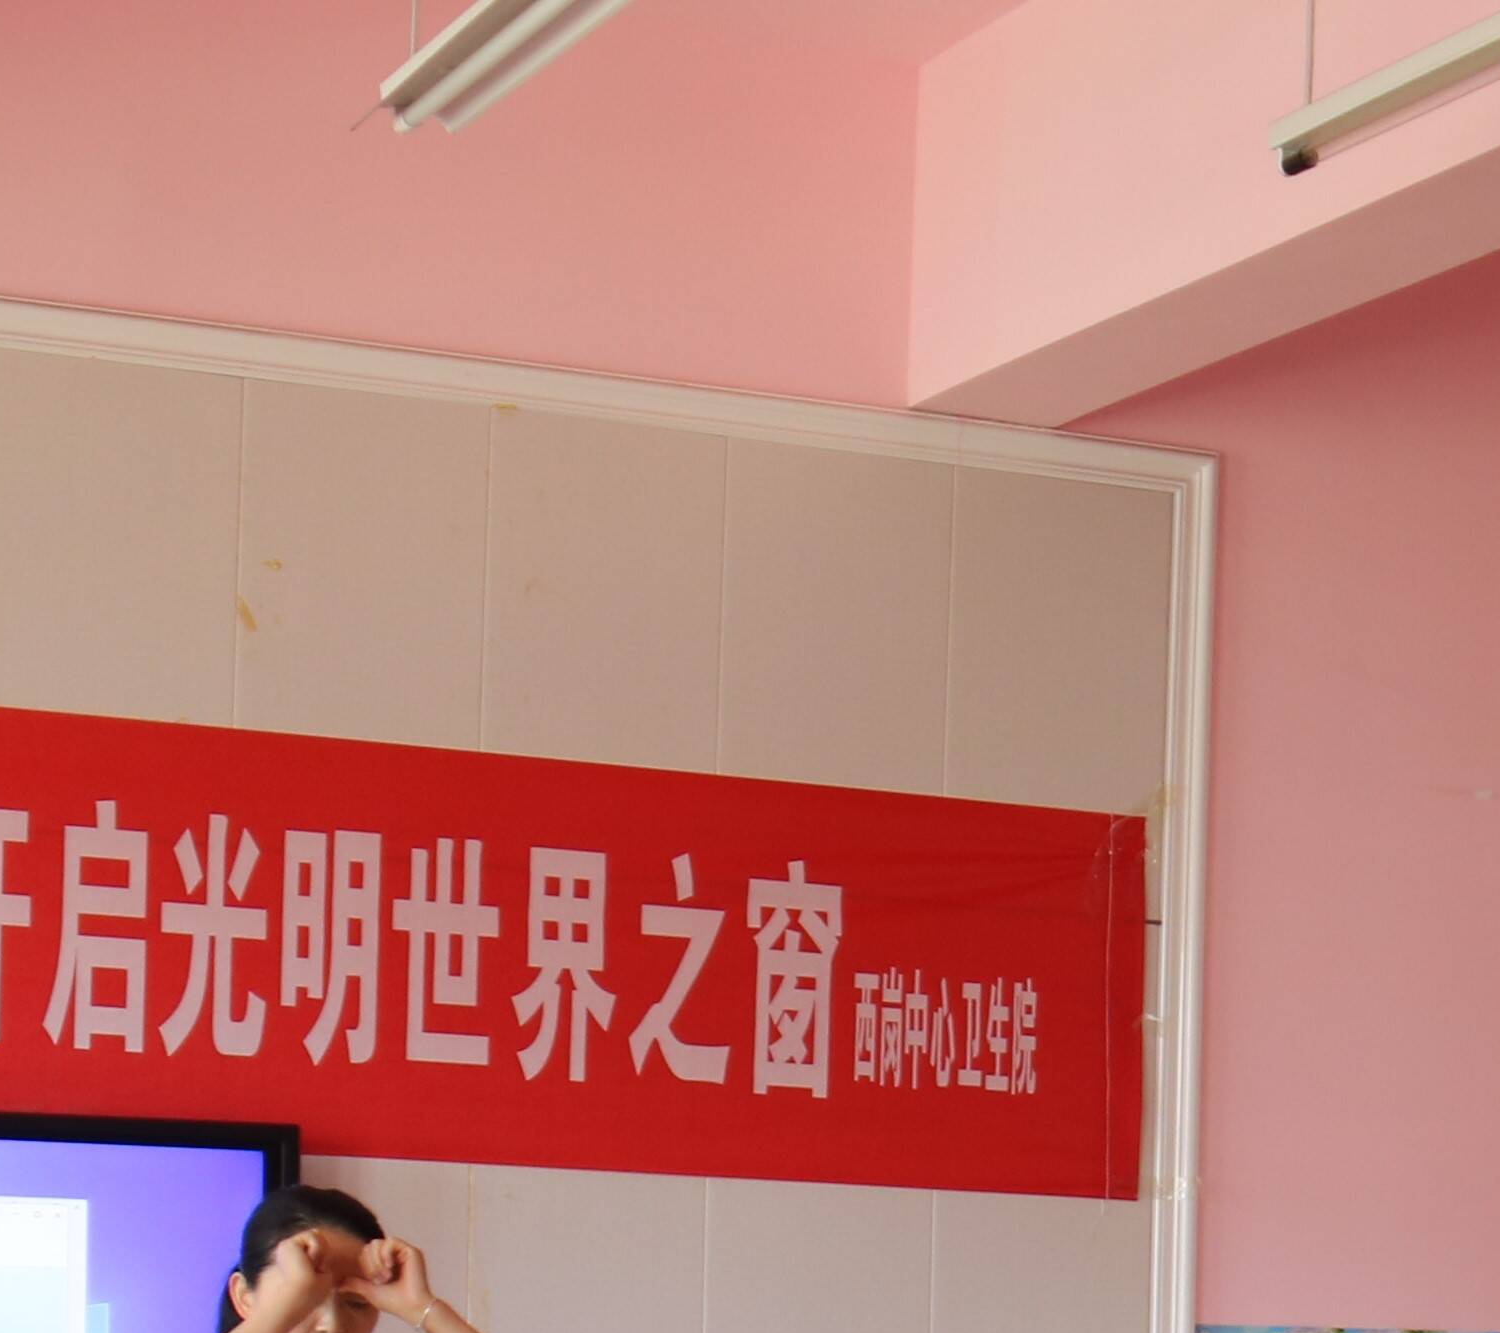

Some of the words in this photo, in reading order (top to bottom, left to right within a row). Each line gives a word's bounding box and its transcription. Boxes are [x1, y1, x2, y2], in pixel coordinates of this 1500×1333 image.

[852, 968, 1037, 1096] 西岗中心卫生院
